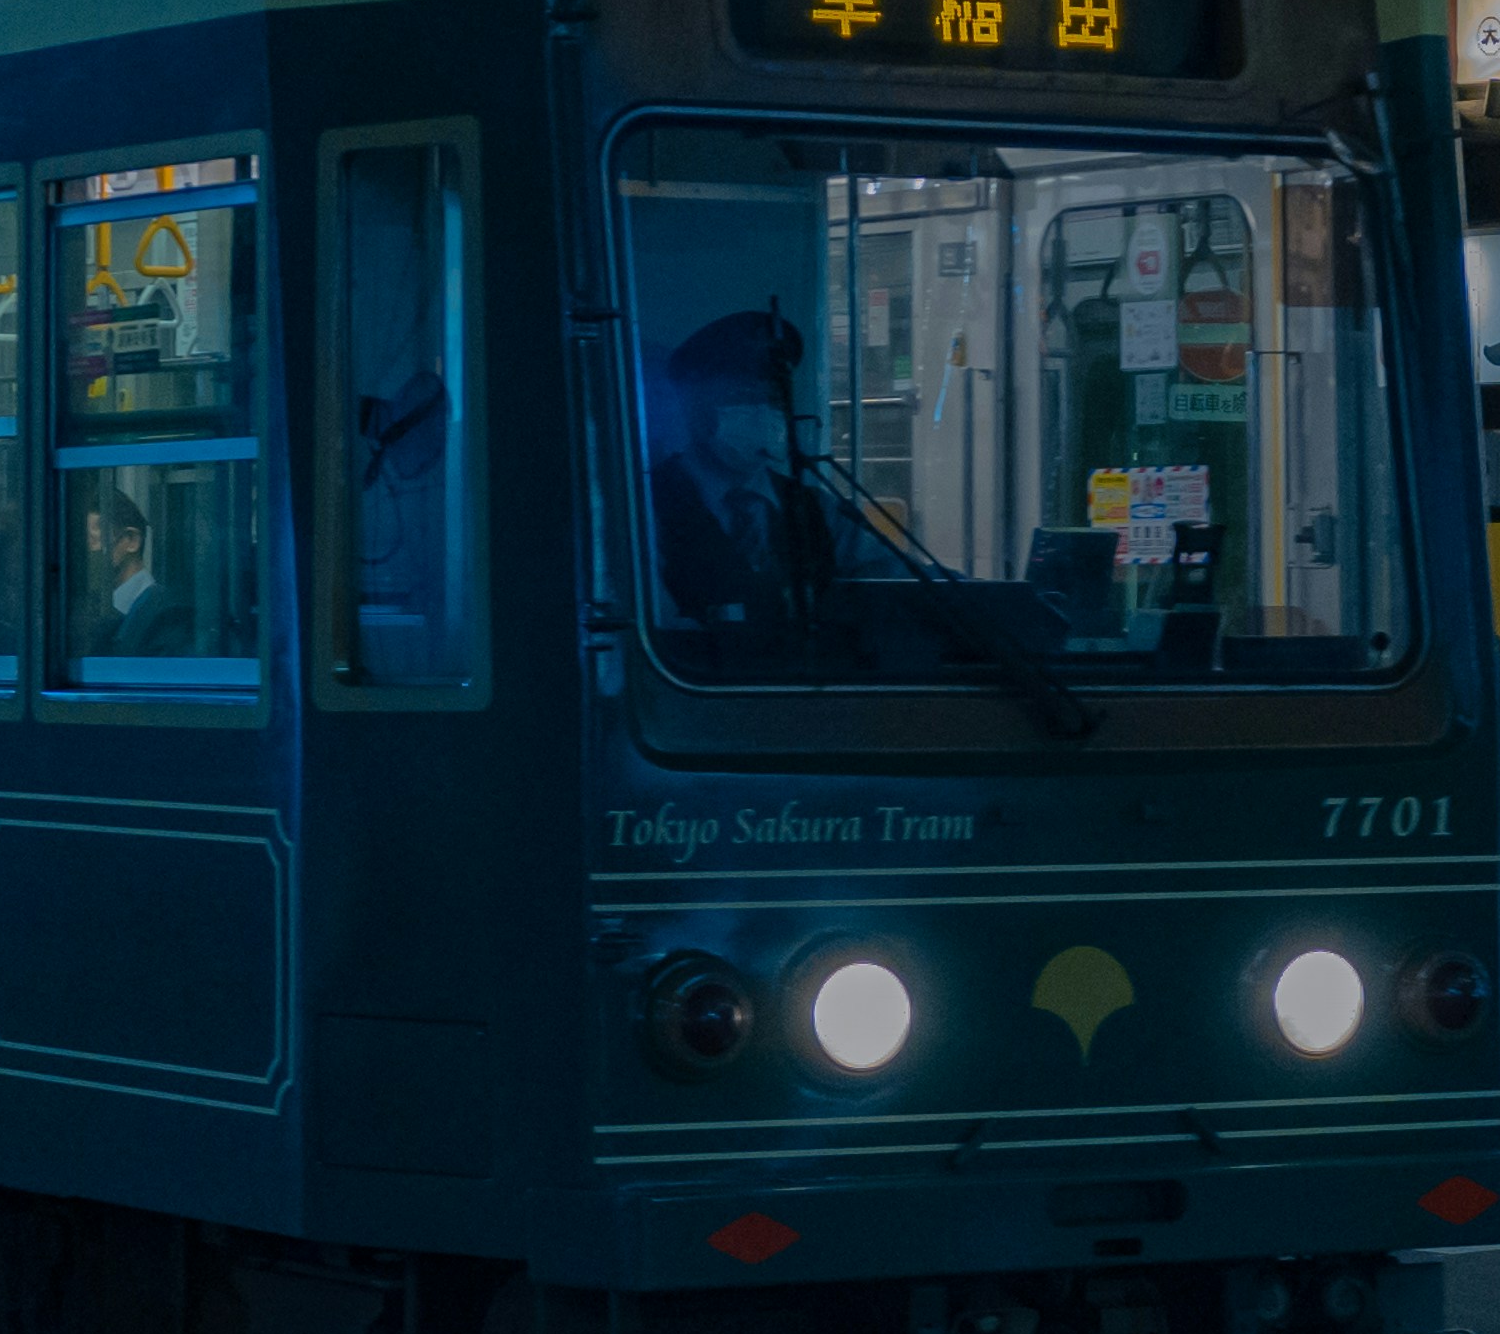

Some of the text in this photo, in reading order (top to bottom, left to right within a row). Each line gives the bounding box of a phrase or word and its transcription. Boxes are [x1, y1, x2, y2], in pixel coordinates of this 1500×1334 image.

[608, 803, 976, 863] Tokyo Sakura Tram
[1321, 796, 1455, 838] 7701
